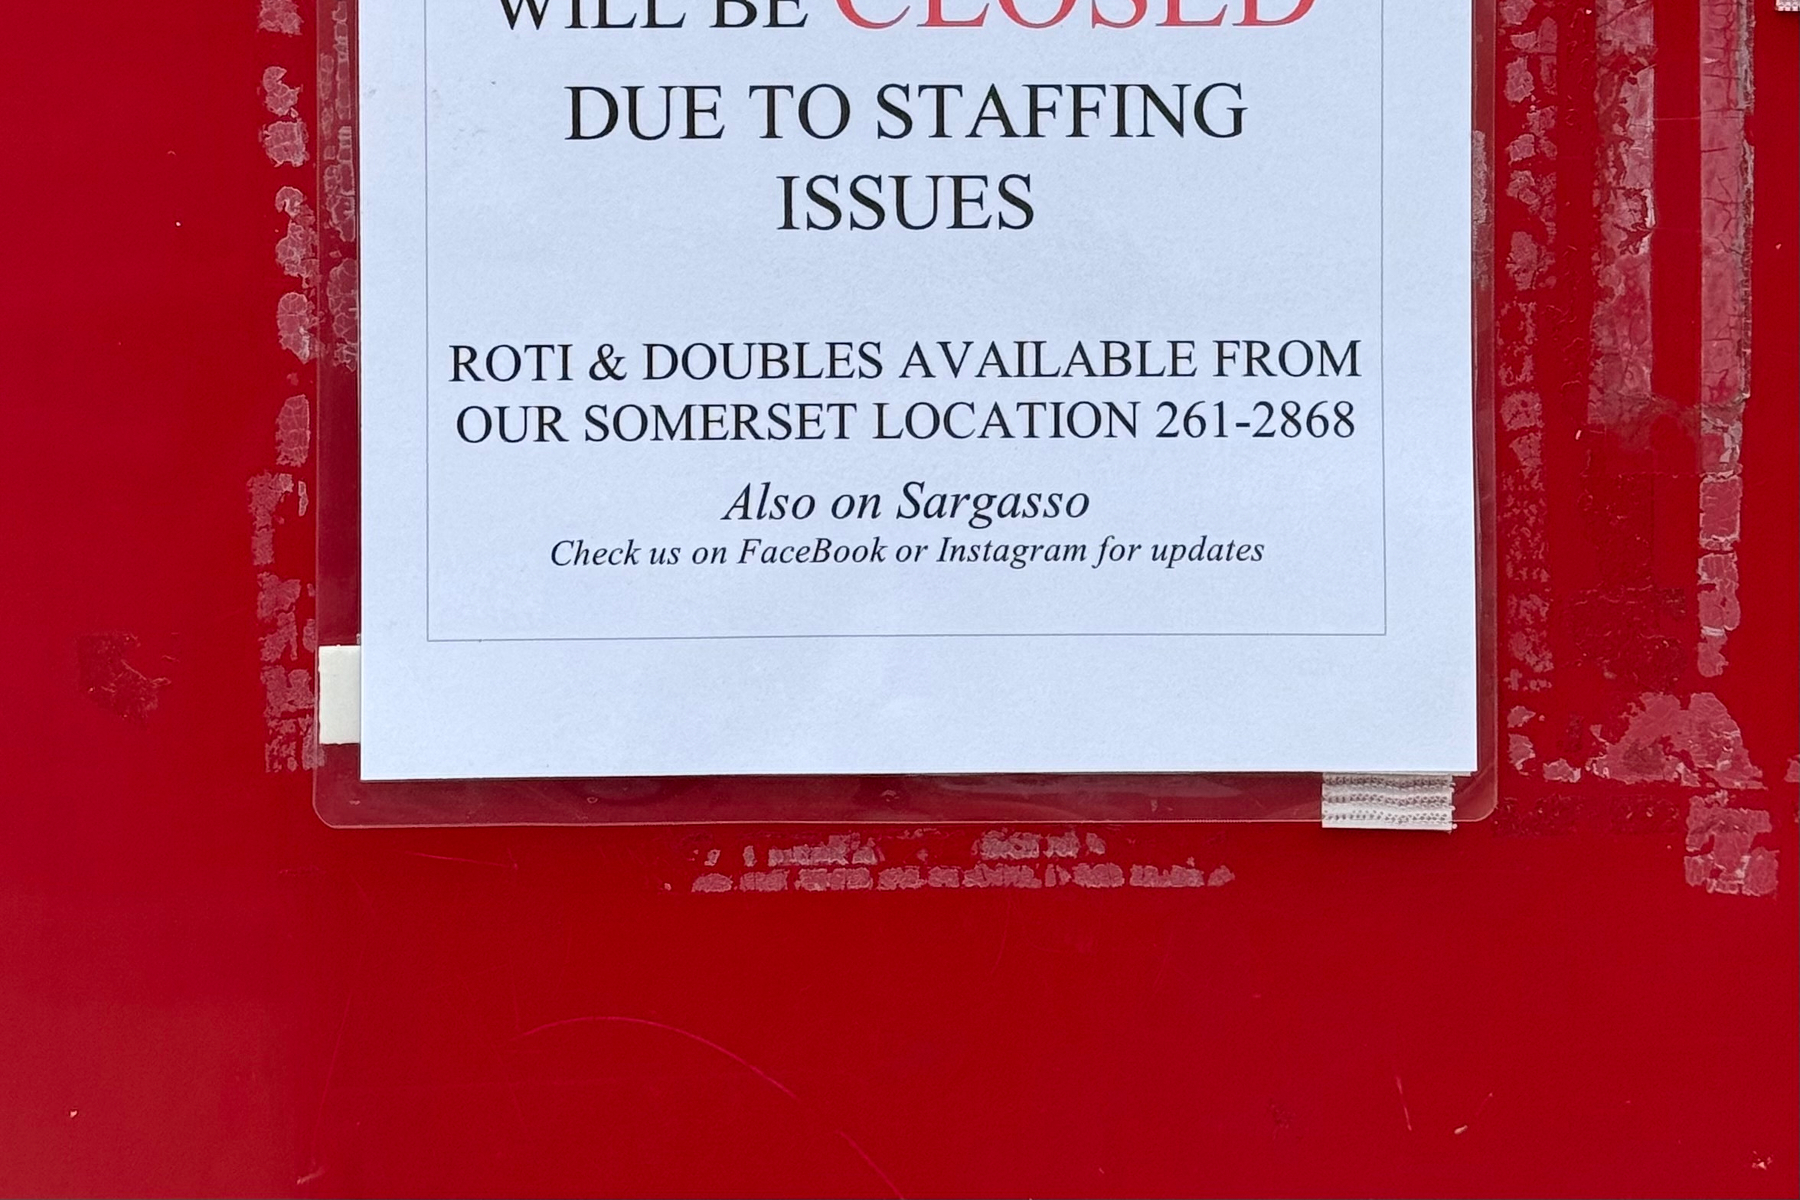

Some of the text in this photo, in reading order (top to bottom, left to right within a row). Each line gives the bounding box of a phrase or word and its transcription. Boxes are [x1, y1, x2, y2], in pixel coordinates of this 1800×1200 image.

[564, 83, 1248, 140] DUE TO STAFFING
[776, 174, 1034, 230] ISSUES
[449, 340, 1361, 383] ROTI & DOUBLES AVAILABLE FROM
[457, 401, 1355, 444] OUR SOMERSET LOCATION 261-2868
[721, 481, 1090, 529] Also on Sargasso
[550, 534, 1265, 569] Check us on FaceBook or Instagram for updates
